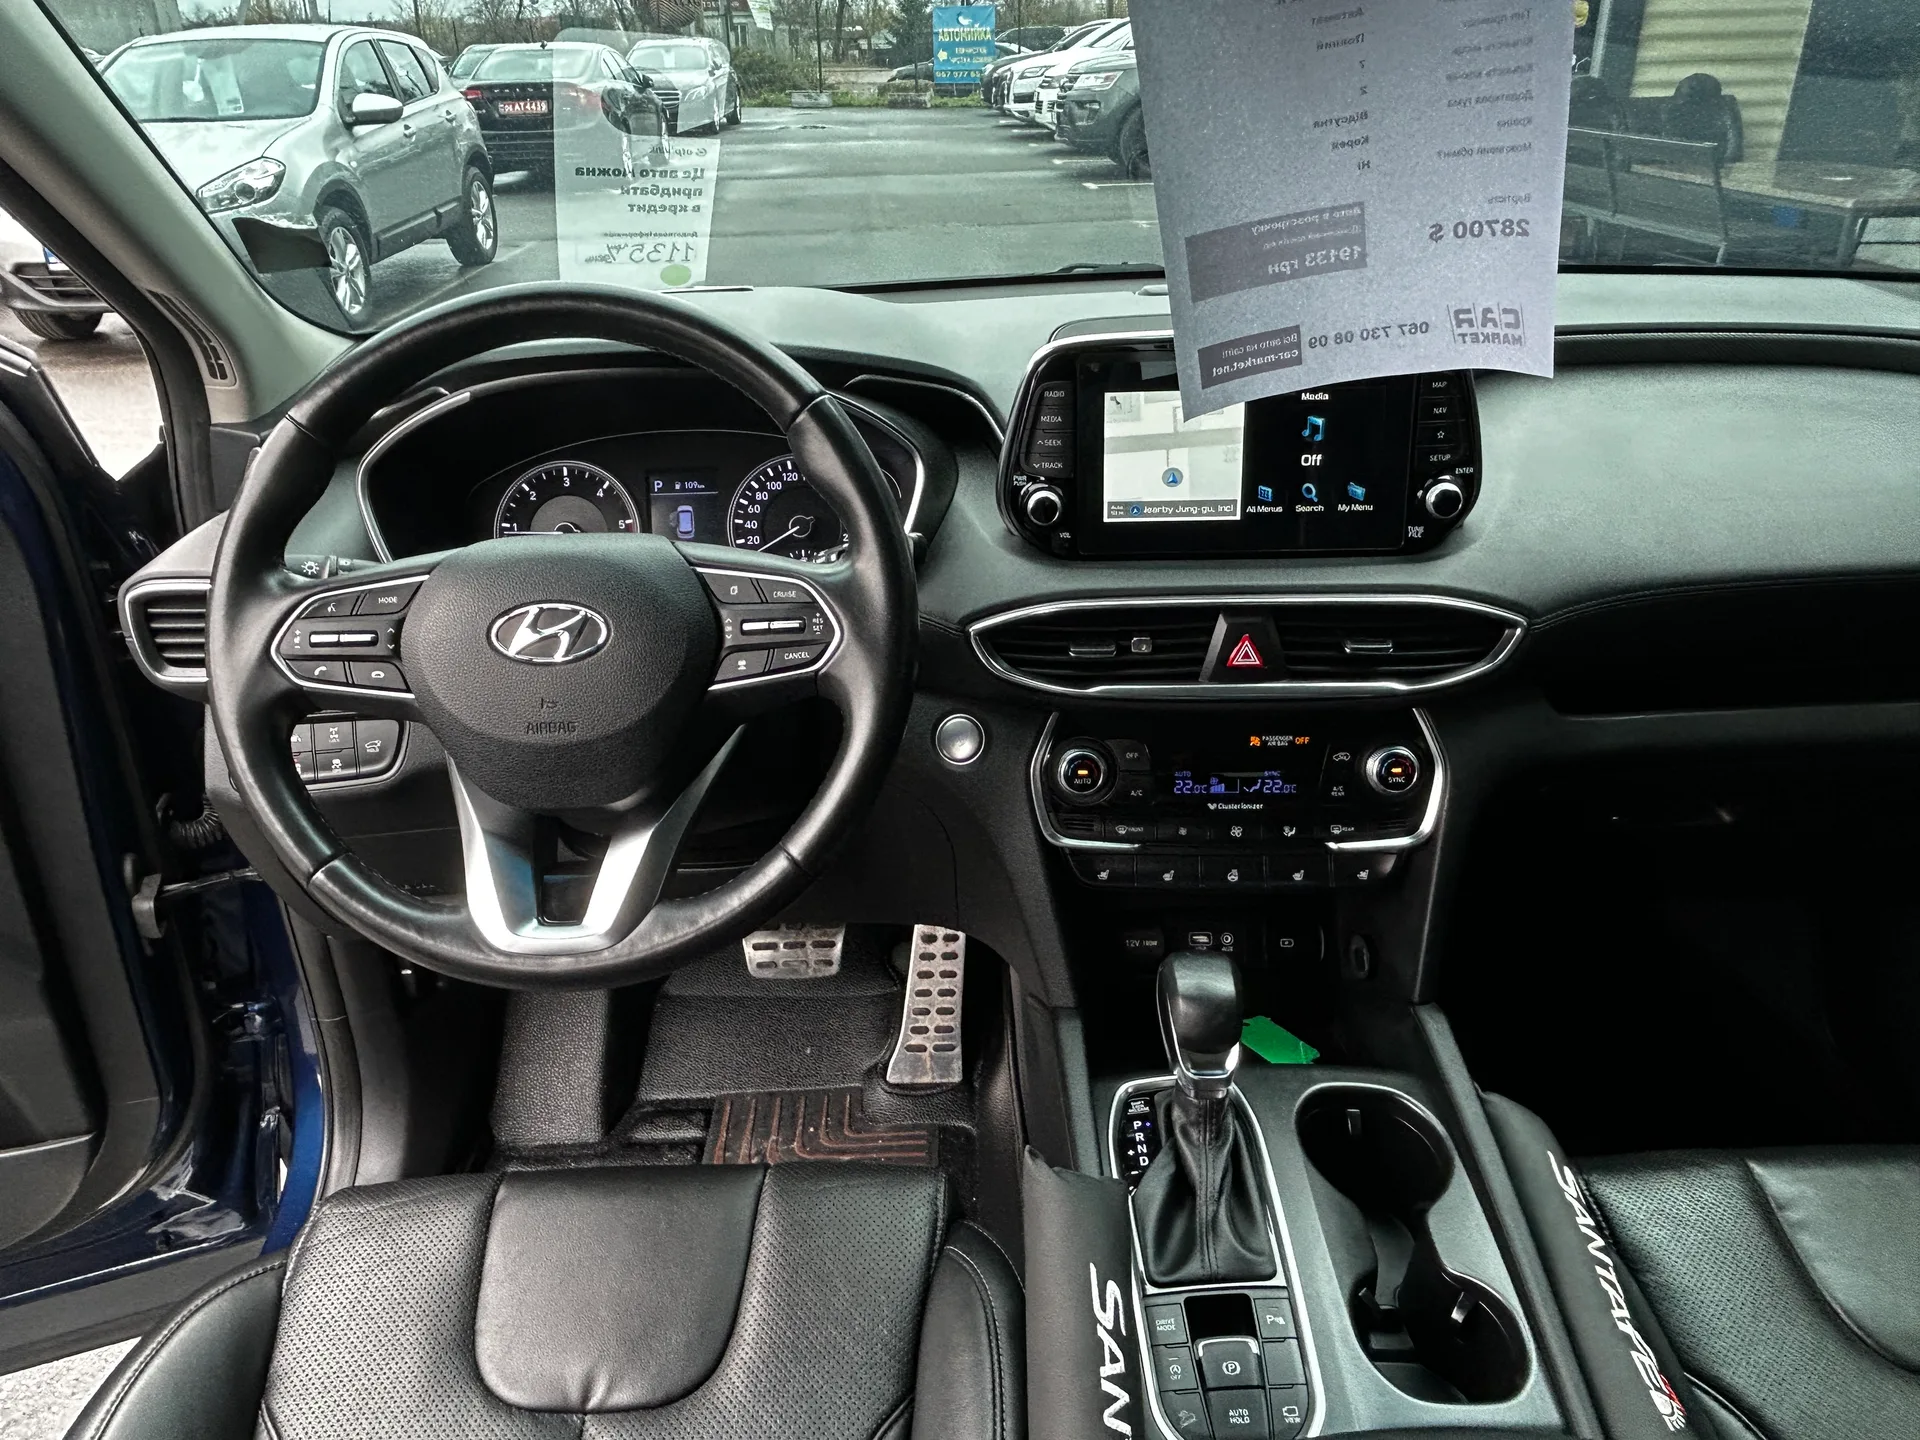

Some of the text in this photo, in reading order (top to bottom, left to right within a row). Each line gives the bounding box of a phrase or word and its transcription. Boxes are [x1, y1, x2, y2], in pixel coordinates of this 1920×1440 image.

[1044, 390, 1065, 398] RADIO
[1301, 392, 1329, 401] Media
[1040, 415, 1063, 423] MEDIA
[1044, 439, 1062, 447] SEEK
[1301, 454, 1322, 467] Off
[1430, 454, 1451, 462] SETUP
[782, 472, 798, 482] 120
[564, 478, 570, 487] 3
[654, 480, 663, 492] P
[766, 481, 782, 491] 100
[530, 492, 537, 501] 2
[596, 488, 604, 498] 4
[755, 492, 769, 501] 80
[748, 504, 761, 514] 60
[1246, 505, 1283, 513] All Menus
[1295, 504, 1325, 512] Search
[1338, 503, 1374, 512] My Menu
[513, 522, 517, 532] 1
[618, 520, 625, 530] 5
[744, 520, 758, 530] 40
[747, 536, 760, 545] 20
[378, 597, 398, 605] MODE
[784, 652, 810, 660] CANCEL
[526, 722, 578, 735] AIRBAG
[1295, 736, 1310, 745] OFF
[1133, 1121, 1142, 1130] P
[1135, 1132, 1145, 1142] R
[1137, 1144, 1148, 1154] N
[1139, 1156, 1149, 1166] D
[1156, 1324, 1176, 1332] MODE
[1089, 1262, 1132, 1440] SAN
[1230, 1416, 1250, 1424] HOLD
